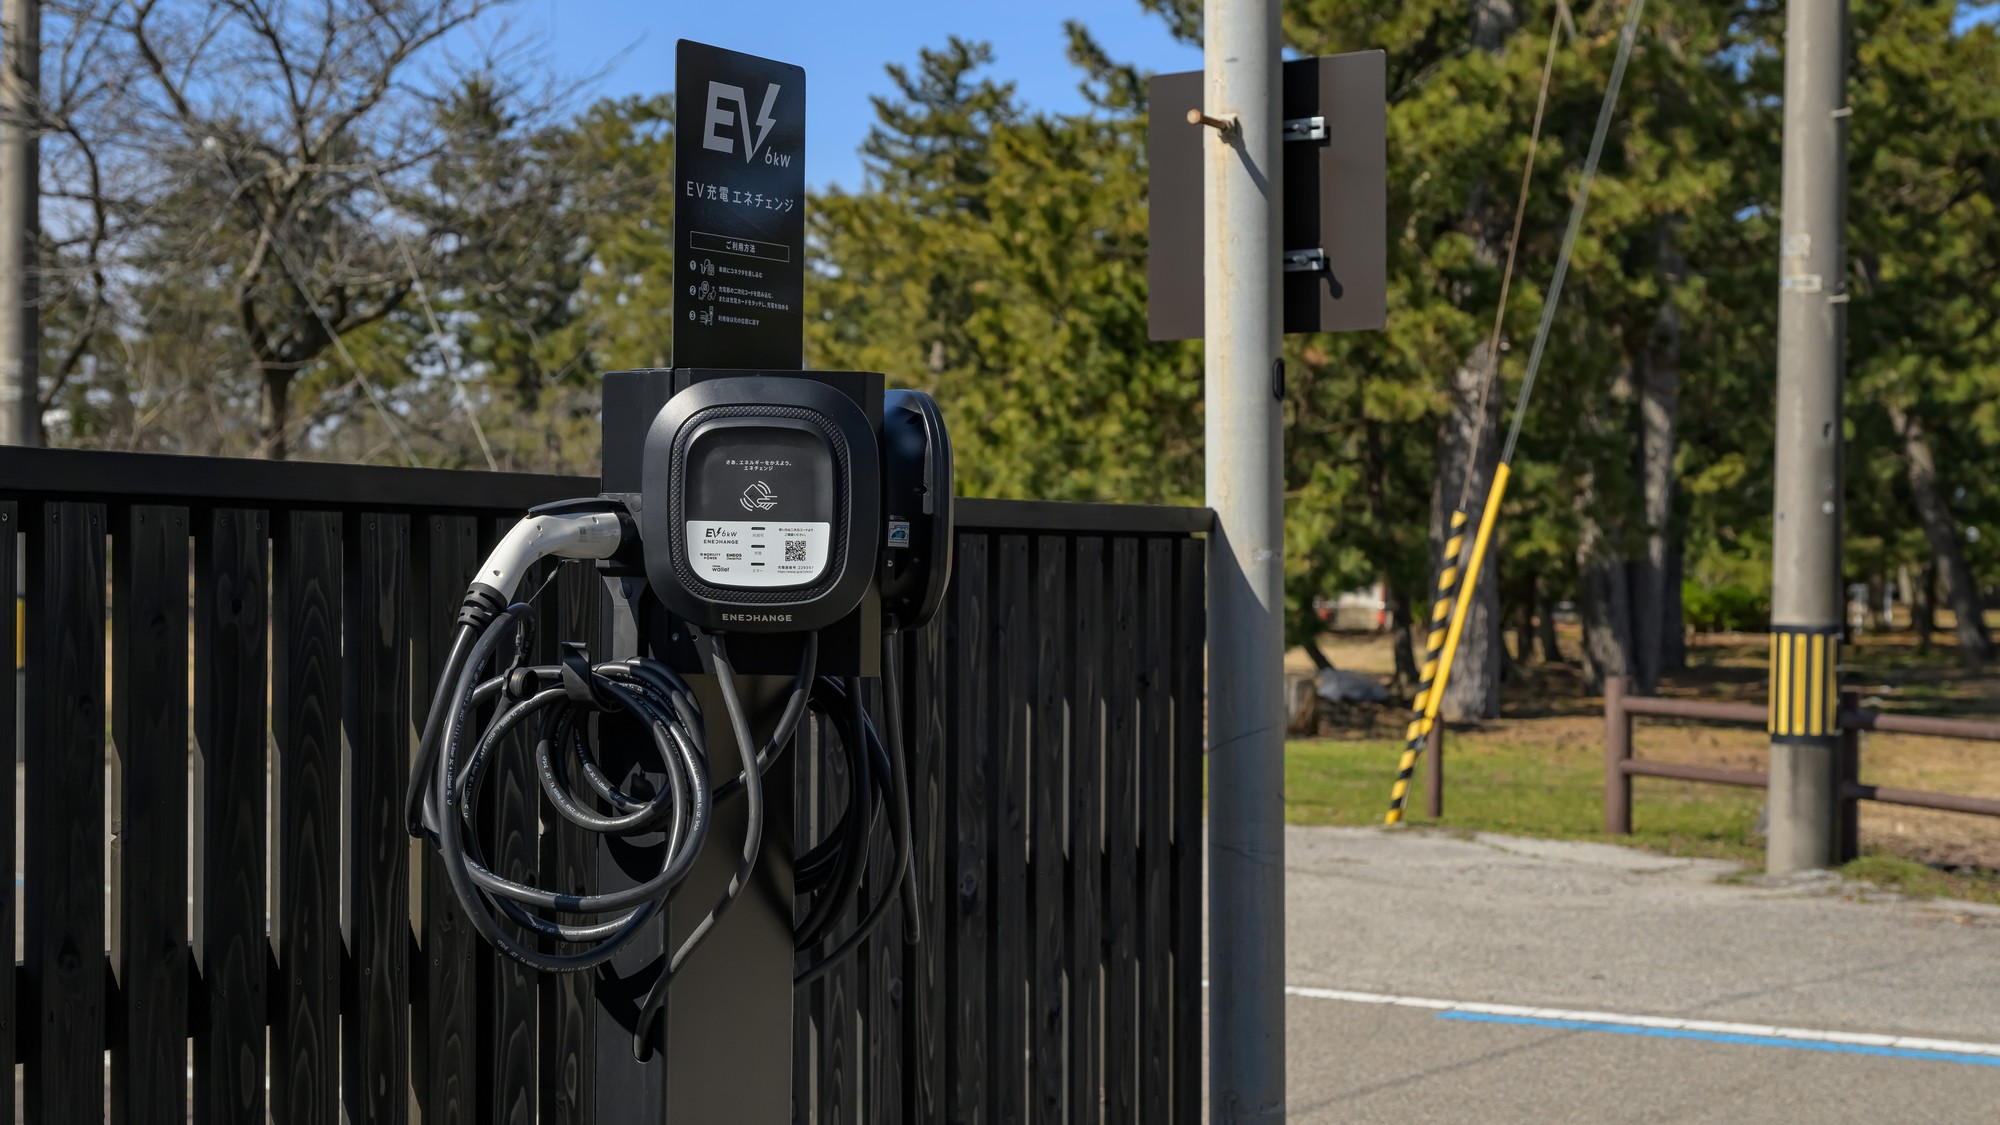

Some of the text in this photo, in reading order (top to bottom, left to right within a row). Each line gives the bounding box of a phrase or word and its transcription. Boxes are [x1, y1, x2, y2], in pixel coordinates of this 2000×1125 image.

[703, 80, 781, 164] EV
[765, 146, 791, 168] 6kW
[686, 180, 794, 213] EV充電 エネチェンジ
[725, 240, 756, 254] ご利用方法
[705, 527, 738, 538] EV 6kW
[722, 613, 793, 622] ENECHANGE
